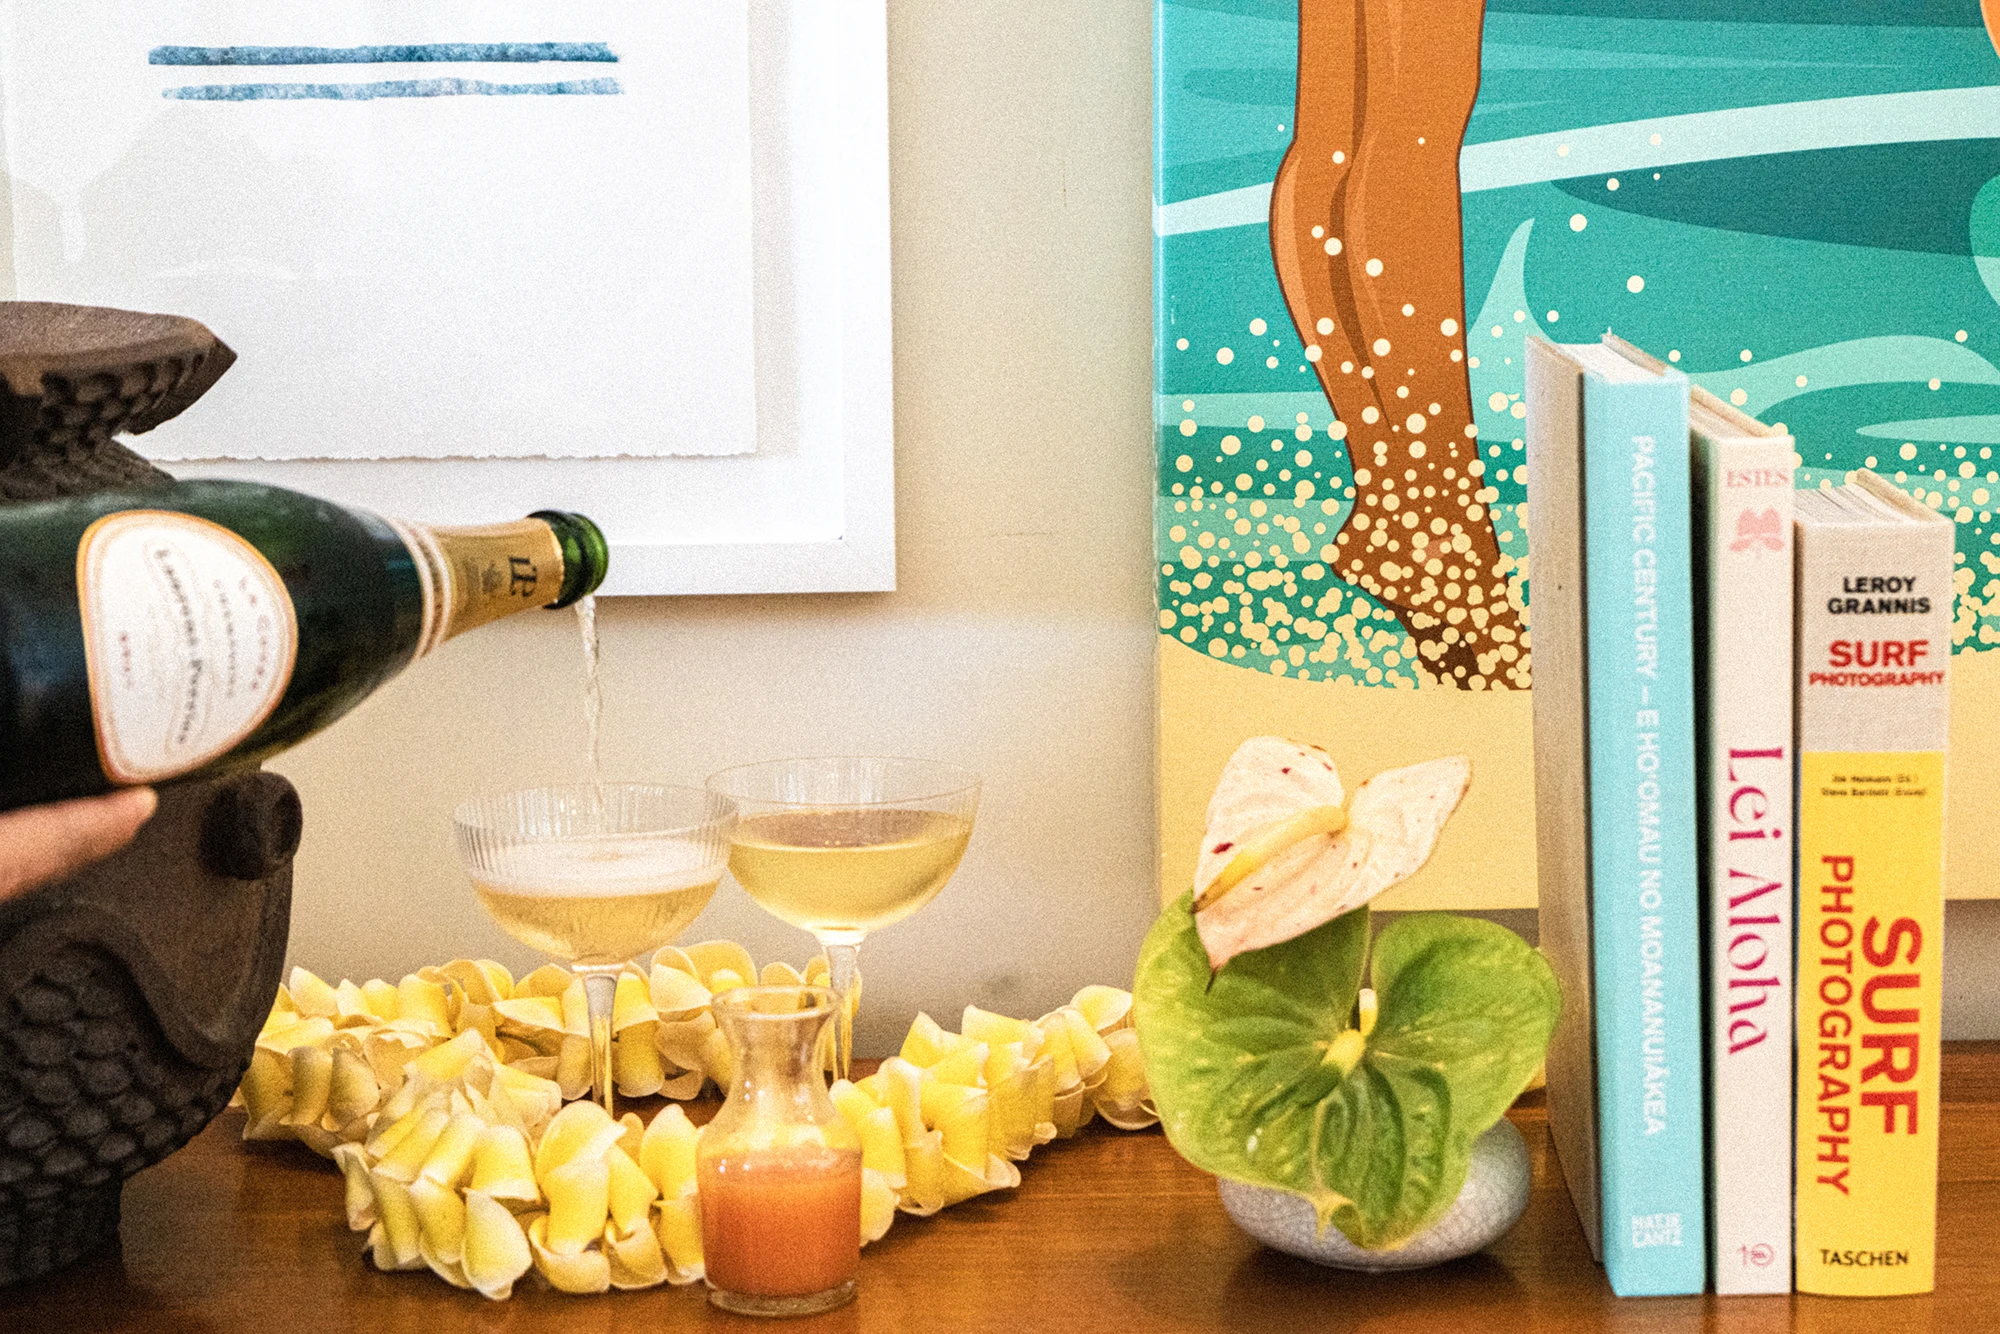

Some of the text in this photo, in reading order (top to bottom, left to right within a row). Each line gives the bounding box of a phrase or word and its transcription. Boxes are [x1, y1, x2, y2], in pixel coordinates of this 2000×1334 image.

[1632, 435, 1656, 543] PACIFIC
[1843, 576, 1917, 594] LEROY
[1633, 547, 1659, 678] CENTURY
[1827, 597, 1931, 615] GRANNIS
[1829, 639, 1930, 668] SURF
[1809, 671, 1945, 688] PHOTOGRAPHY
[1636, 709, 1659, 728] E
[1639, 868, 1662, 910] NO
[1728, 747, 1784, 1056] Lei Aloha
[1816, 855, 1855, 1196] PHOTOGRAPHY
[1860, 916, 1923, 1136] SURF
[1820, 1248, 1910, 1267] TASCHEN
